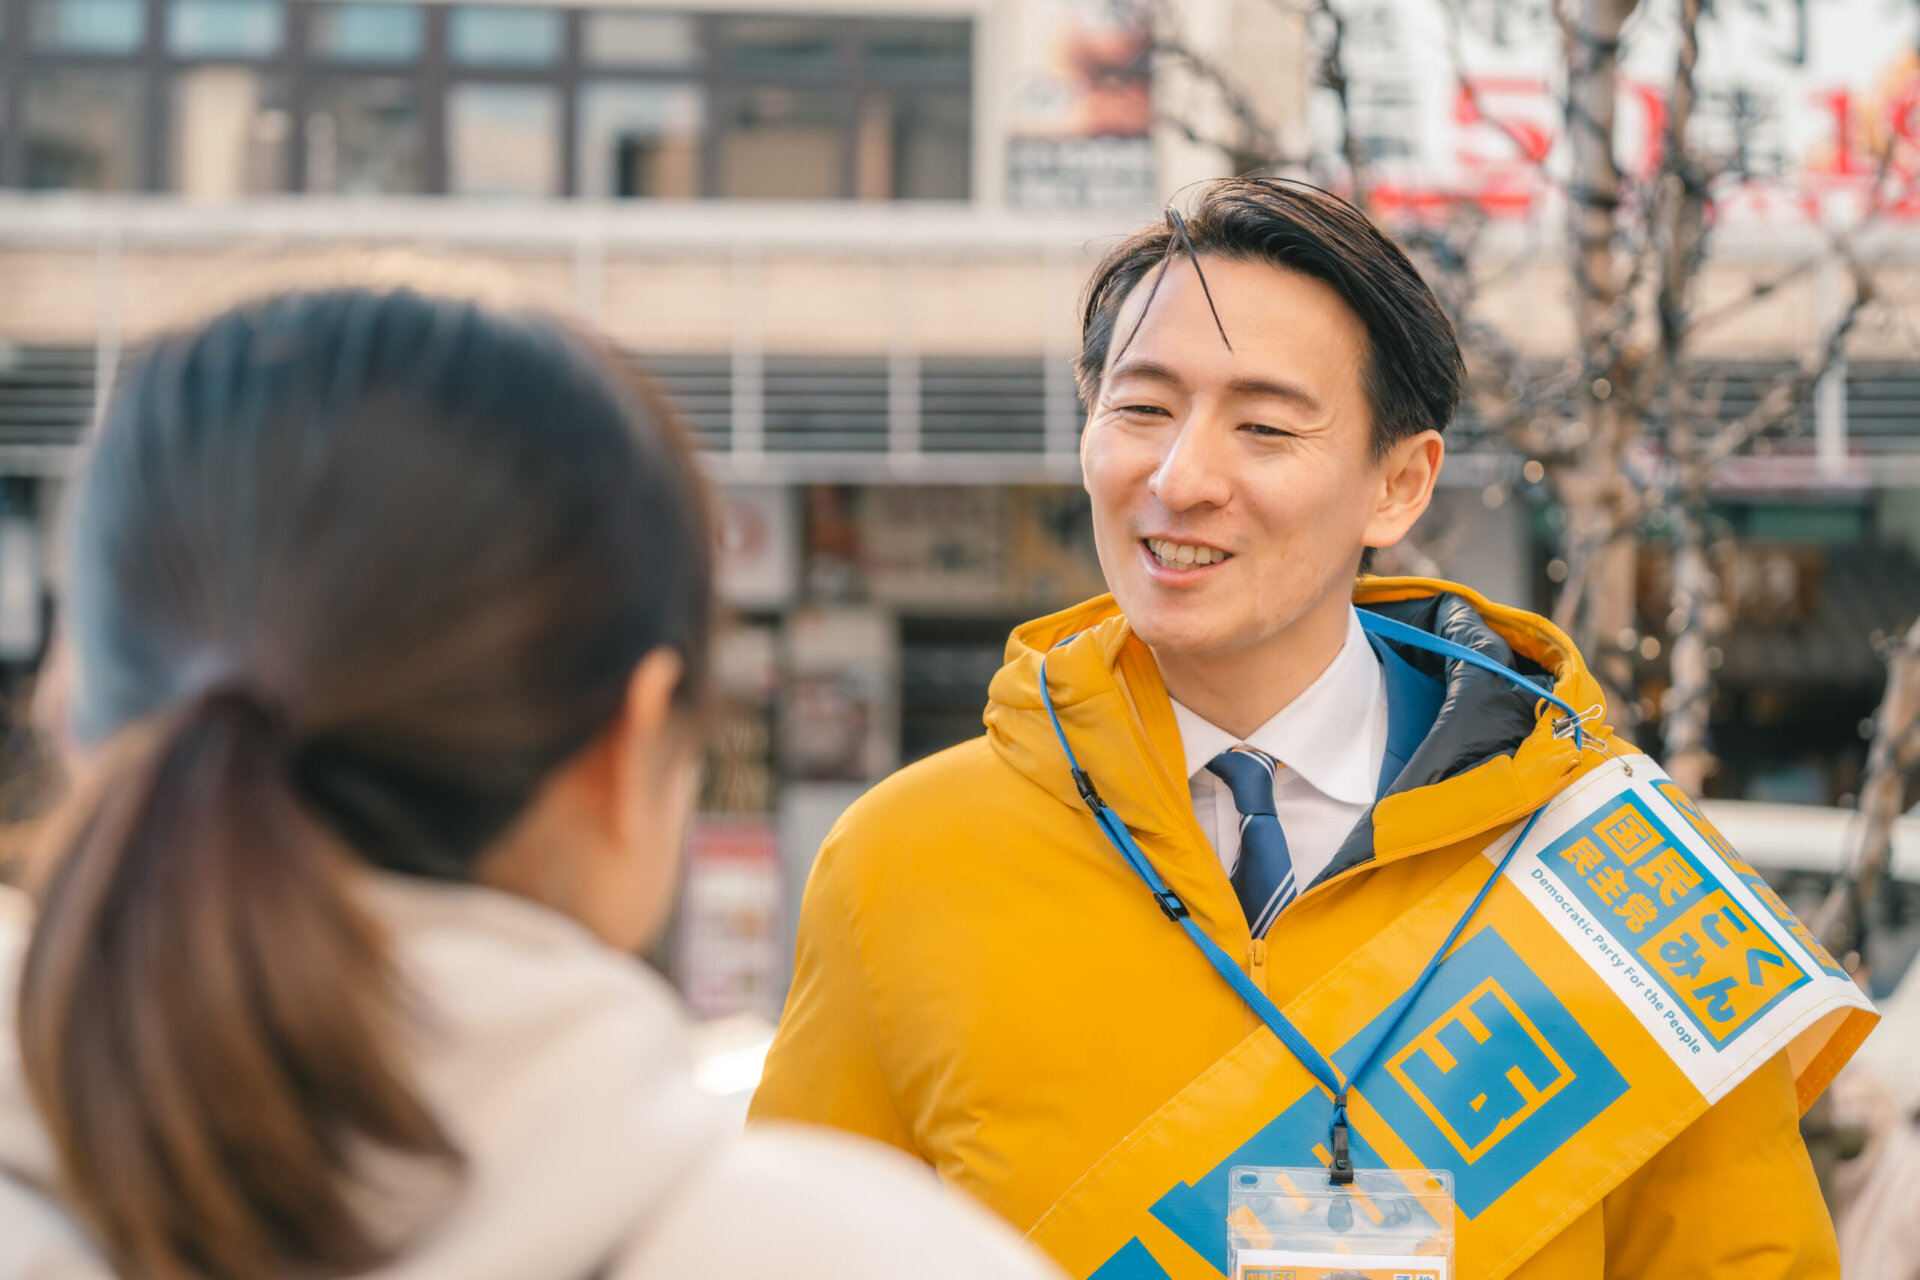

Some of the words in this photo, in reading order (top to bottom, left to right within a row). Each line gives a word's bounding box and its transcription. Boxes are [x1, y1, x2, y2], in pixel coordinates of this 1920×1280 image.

[1558, 836, 1659, 934] 民主党
[1592, 802, 1704, 907] 国民
[1531, 868, 1594, 936] Democratic
[1592, 934, 1625, 967] Party
[1623, 966, 1646, 989] For
[1643, 988, 1664, 1011] the
[1663, 1010, 1701, 1054] People
[1659, 931, 1738, 1023] みん
[1700, 905, 1784, 987] こく
